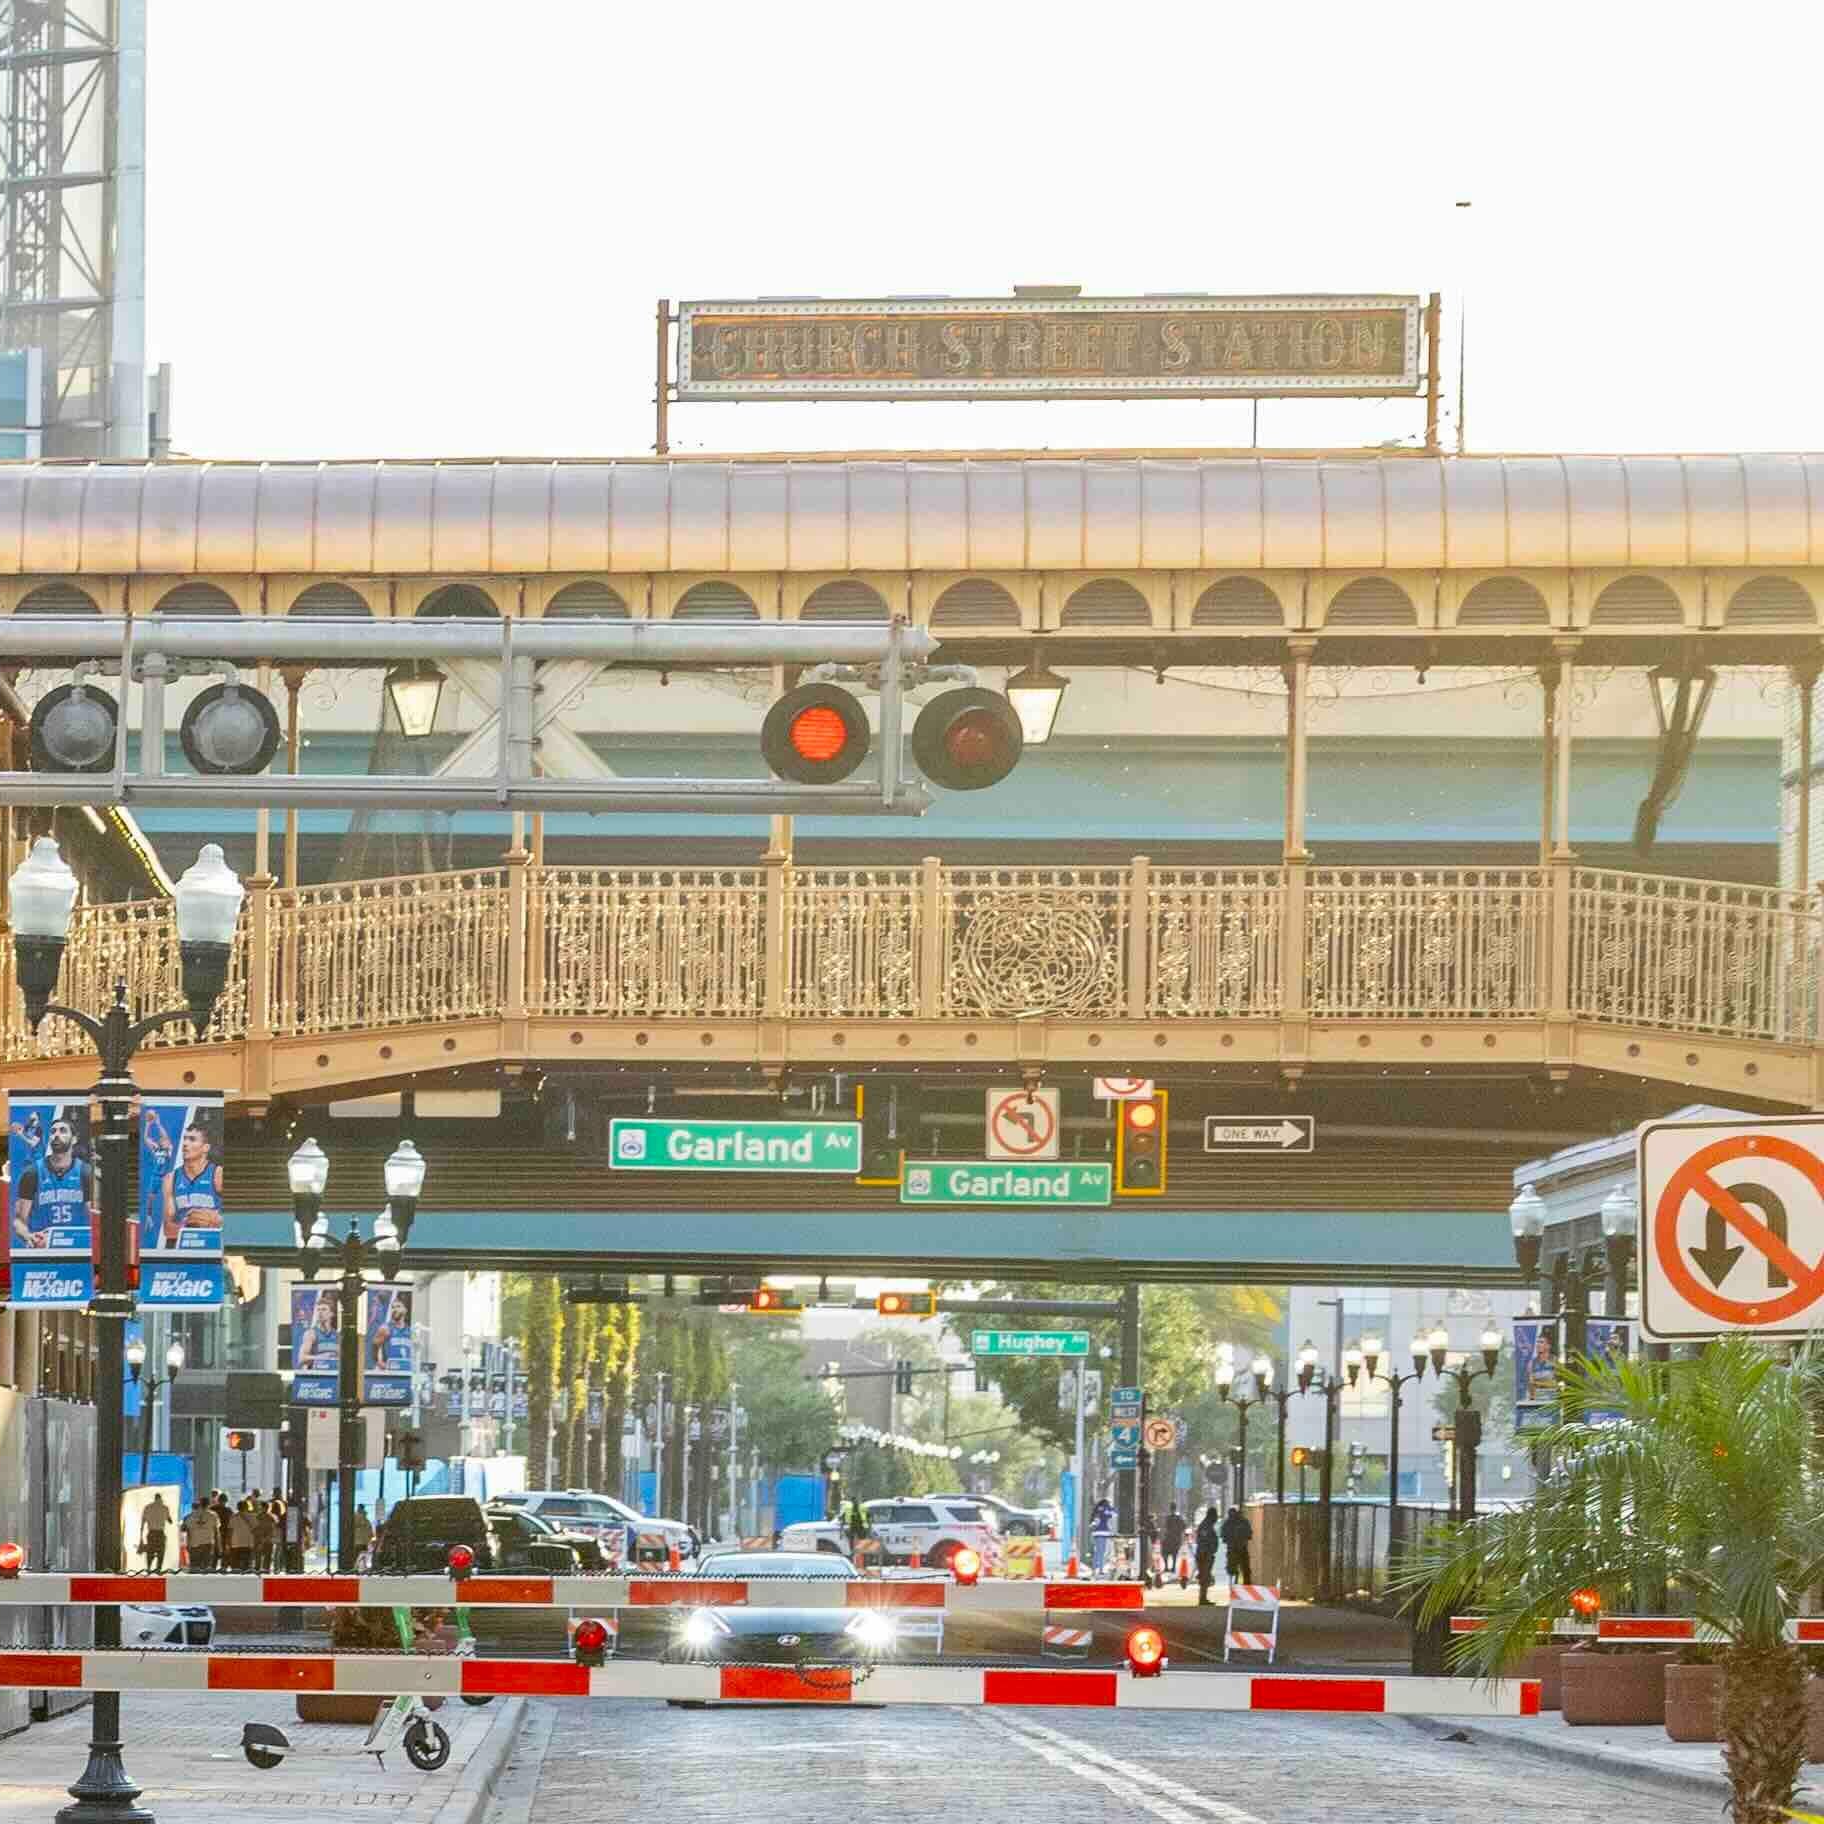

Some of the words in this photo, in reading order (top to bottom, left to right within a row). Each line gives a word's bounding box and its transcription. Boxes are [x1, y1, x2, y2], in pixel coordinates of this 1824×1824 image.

[713, 322, 920, 377] CHURCH
[942, 319, 1137, 375] STREET
[1161, 317, 1385, 373] STATION
[1222, 1128, 1247, 1140] ONE
[1254, 1128, 1280, 1140] WAY
[666, 1129, 814, 1163] Garland
[824, 1132, 853, 1148] Av
[949, 1168, 1071, 1198] Garland
[1079, 1171, 1104, 1185] Av
[51, 1204, 72, 1225] 35
[998, 1334, 1067, 1353] Hughey
[1119, 1428, 1132, 1444] 4
